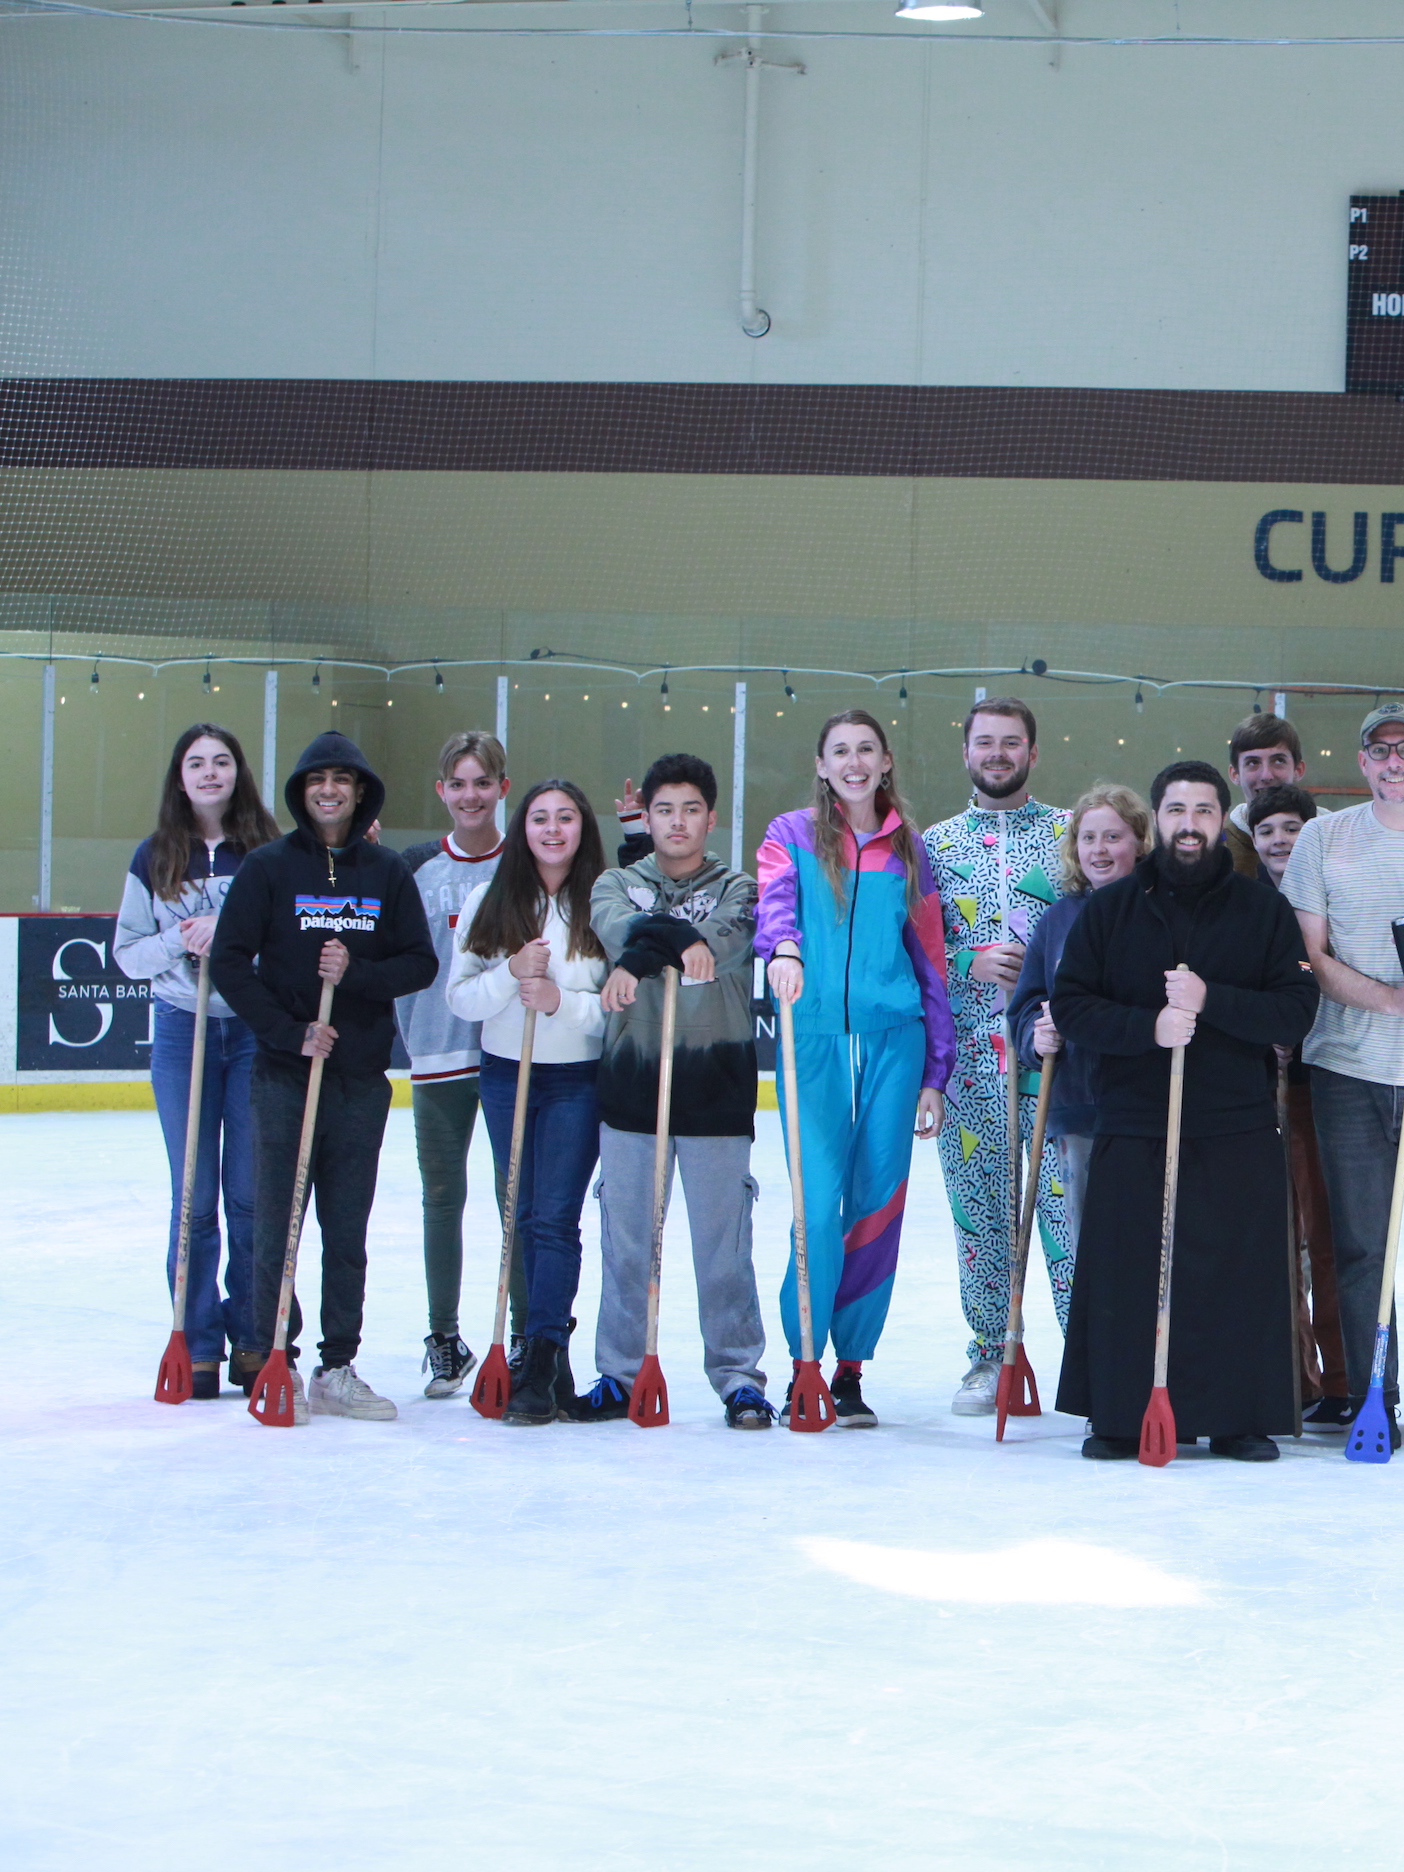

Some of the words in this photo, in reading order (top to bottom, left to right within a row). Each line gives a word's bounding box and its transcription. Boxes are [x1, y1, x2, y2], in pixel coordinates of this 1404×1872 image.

[1350, 207, 1367, 223] P1
[1350, 244, 1368, 260] P2
[300, 915, 376, 933] patagonia
[58, 984, 110, 999] SANTA
